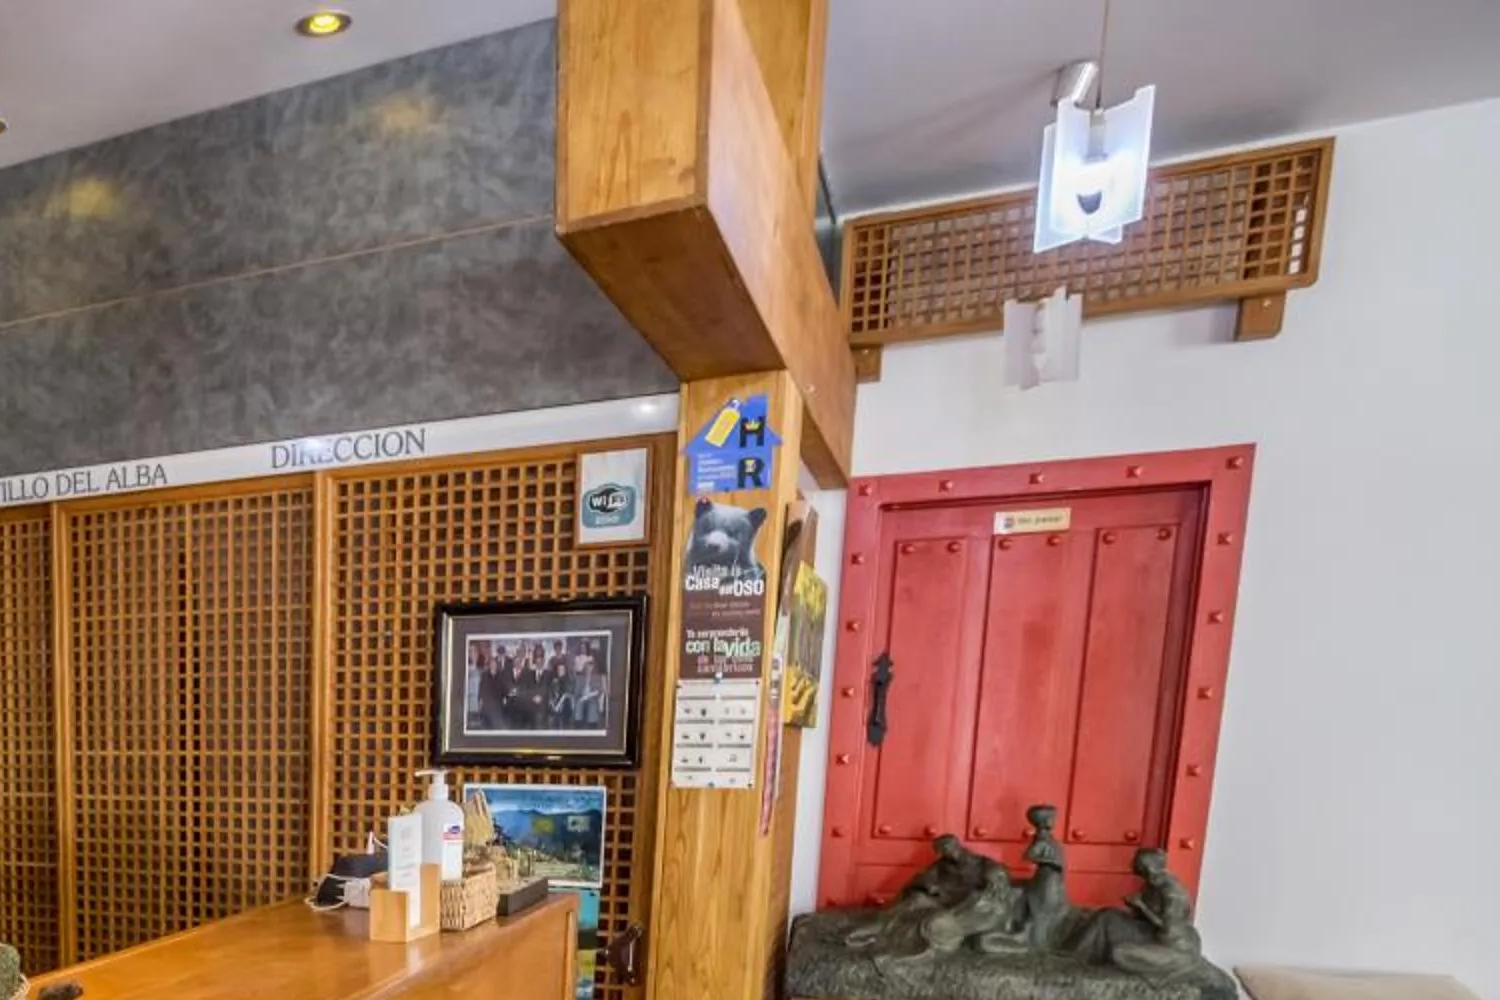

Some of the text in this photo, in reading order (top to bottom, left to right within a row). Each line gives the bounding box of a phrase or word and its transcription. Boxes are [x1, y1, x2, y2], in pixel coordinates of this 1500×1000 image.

[271, 429, 426, 469] DIRECCION
[56, 470, 100, 496] DEL
[106, 463, 167, 491] ALBA
